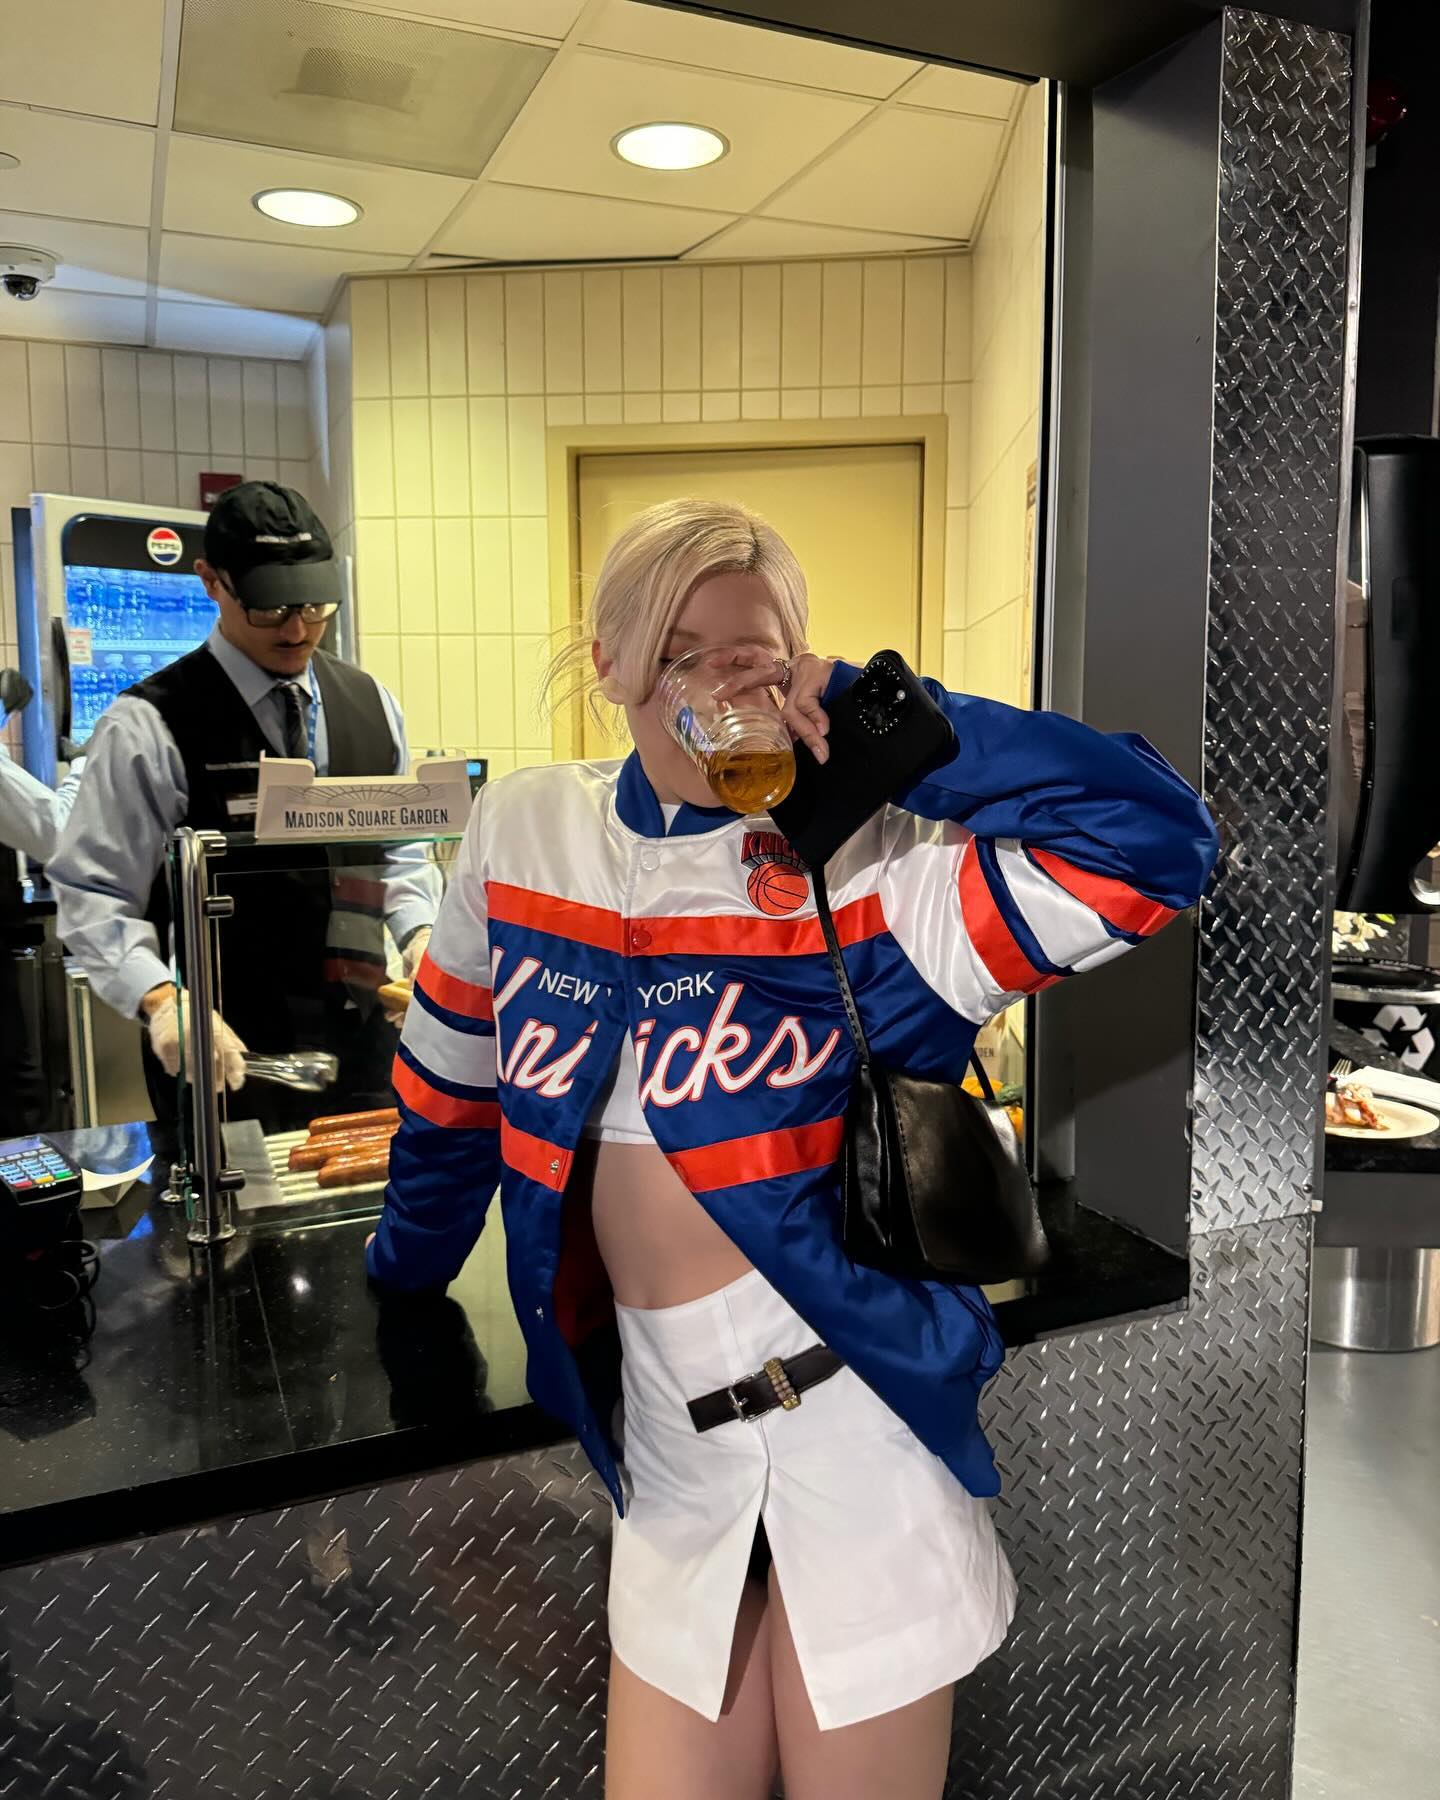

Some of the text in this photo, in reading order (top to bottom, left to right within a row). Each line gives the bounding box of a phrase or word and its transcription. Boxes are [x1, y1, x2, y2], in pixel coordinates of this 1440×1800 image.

[285, 806, 449, 829] MADISON SQUARE GARDEN
[741, 830, 801, 862] KNIC
[537, 967, 715, 1009] NEW YORK
